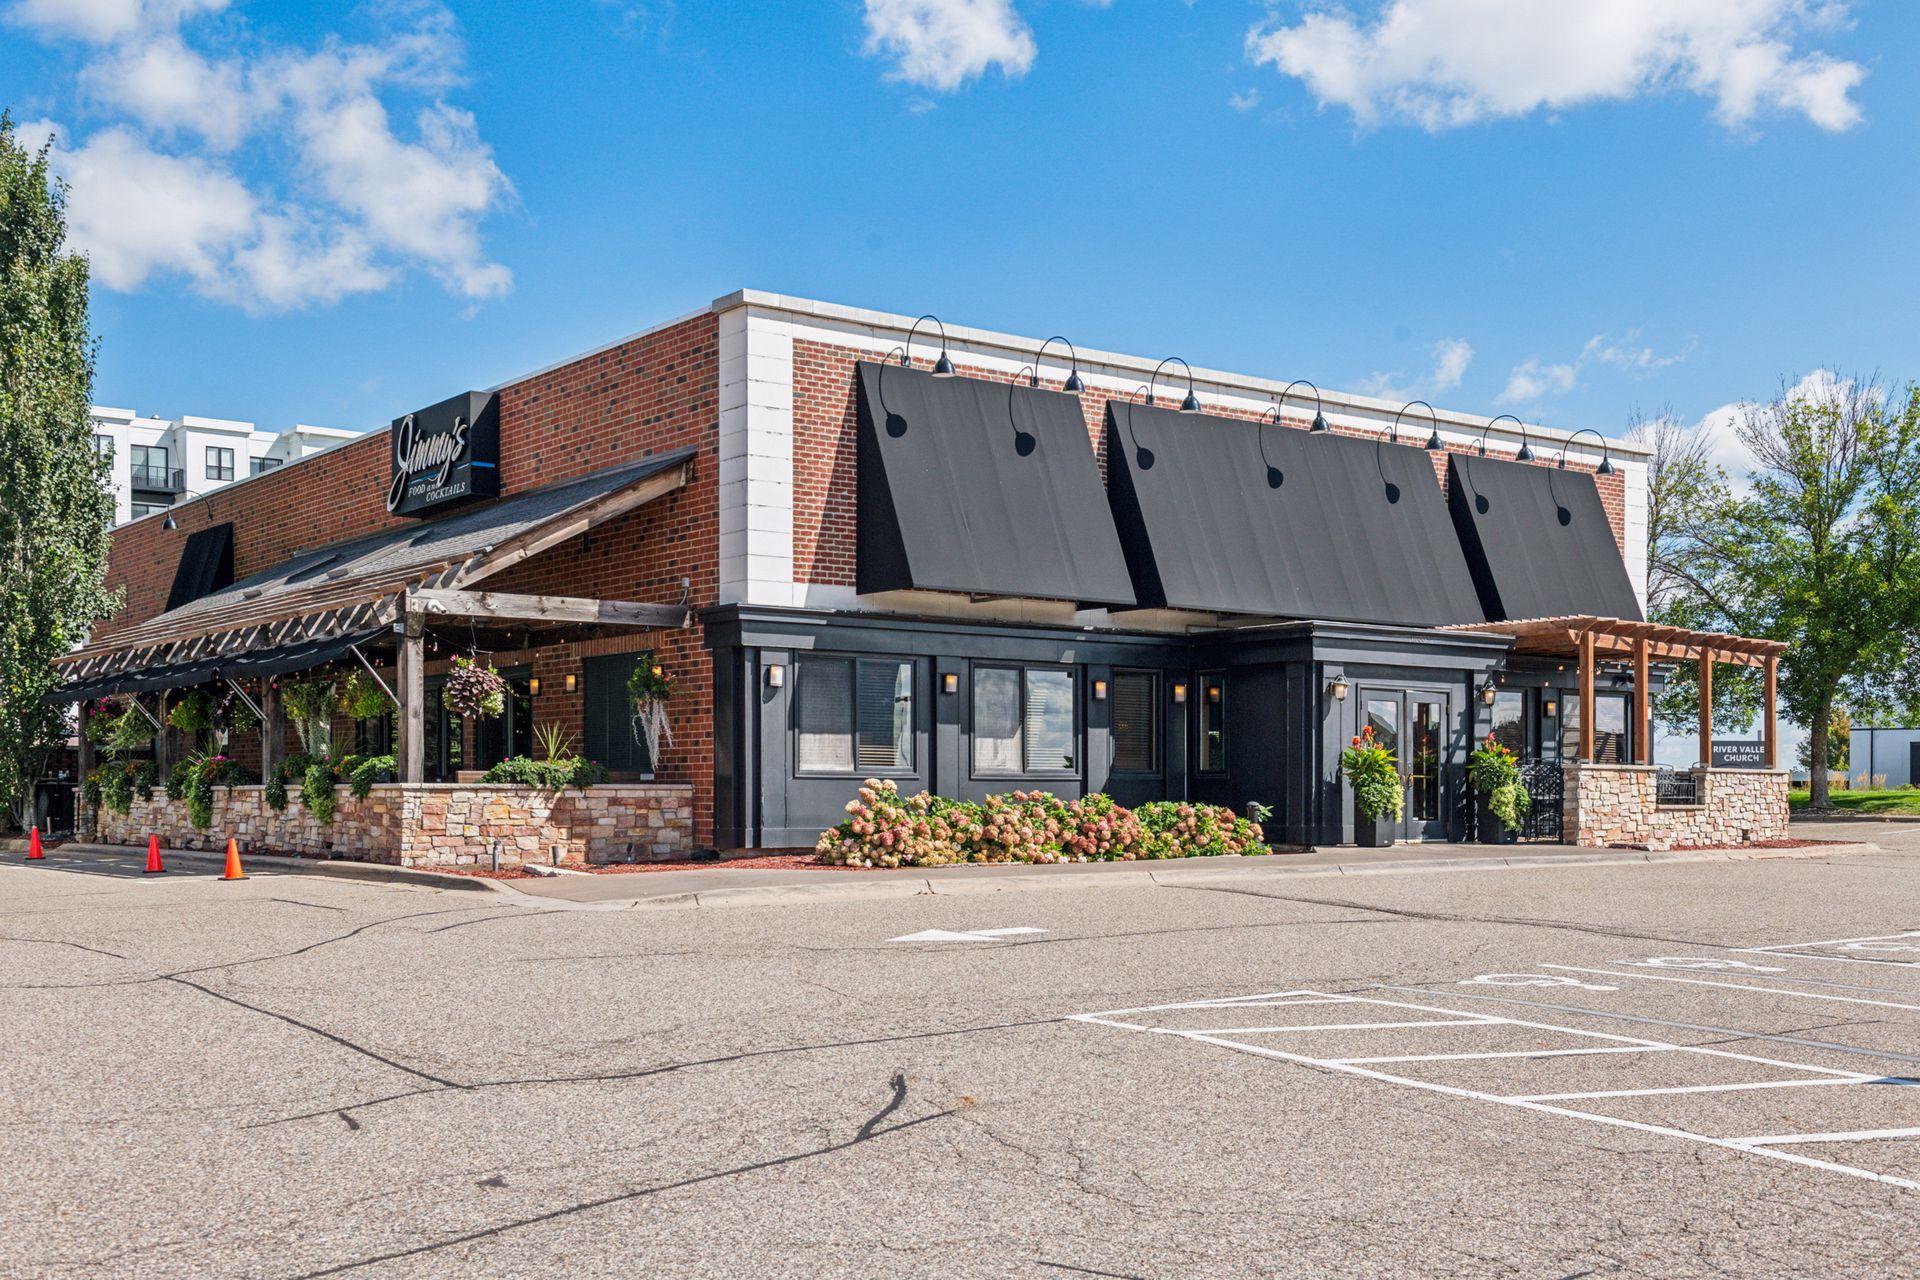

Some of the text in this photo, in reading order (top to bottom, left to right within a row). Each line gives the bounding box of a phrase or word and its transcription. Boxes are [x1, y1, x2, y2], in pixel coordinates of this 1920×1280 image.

[387, 414, 467, 512] Jimmy's
[408, 484, 425, 497] FOOD
[426, 482, 466, 501] COCKTAILS
[1723, 754, 1760, 762] CHURCH
